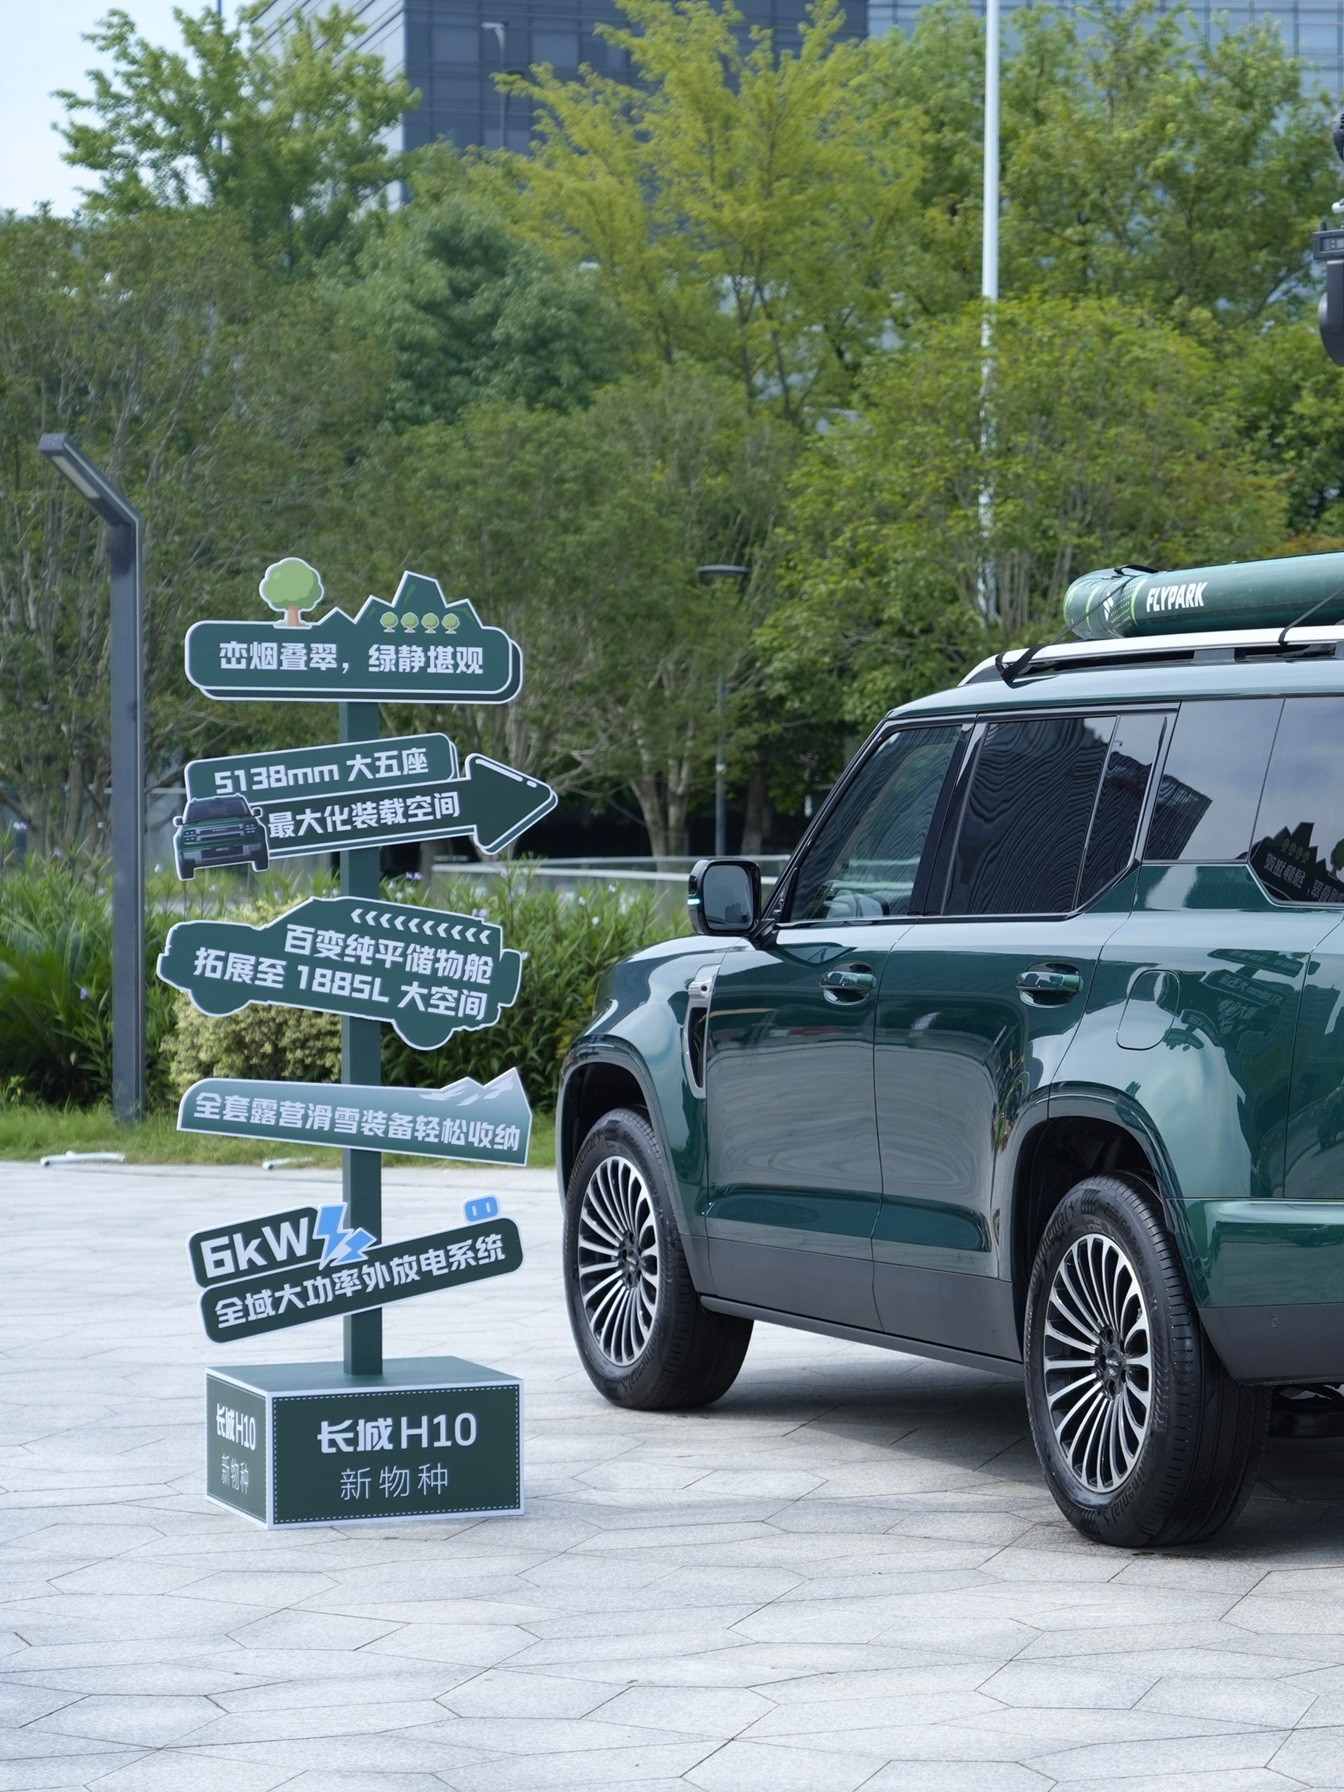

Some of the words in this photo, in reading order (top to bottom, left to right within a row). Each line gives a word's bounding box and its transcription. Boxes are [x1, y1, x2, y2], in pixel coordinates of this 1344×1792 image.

[1146, 582, 1208, 612] FLYPARK
[219, 641, 484, 675] 峦烟叠翠，绿静堪观
[214, 761, 340, 795] 5138mm
[347, 747, 429, 781] 大五座
[268, 791, 461, 839] 最大化装载空间
[284, 923, 495, 985] 百变纯平储物舱
[194, 947, 287, 990] 拓展至
[297, 965, 390, 1003] 1885L
[397, 982, 488, 1021] 大空间
[194, 1091, 521, 1152] 全套露营滑雪装备轻松收纳
[200, 1217, 310, 1279] 6kW
[215, 1233, 506, 1330] 全域大功率外放电系统
[317, 1412, 477, 1455] 长城H10
[340, 1462, 449, 1501] 新物种
